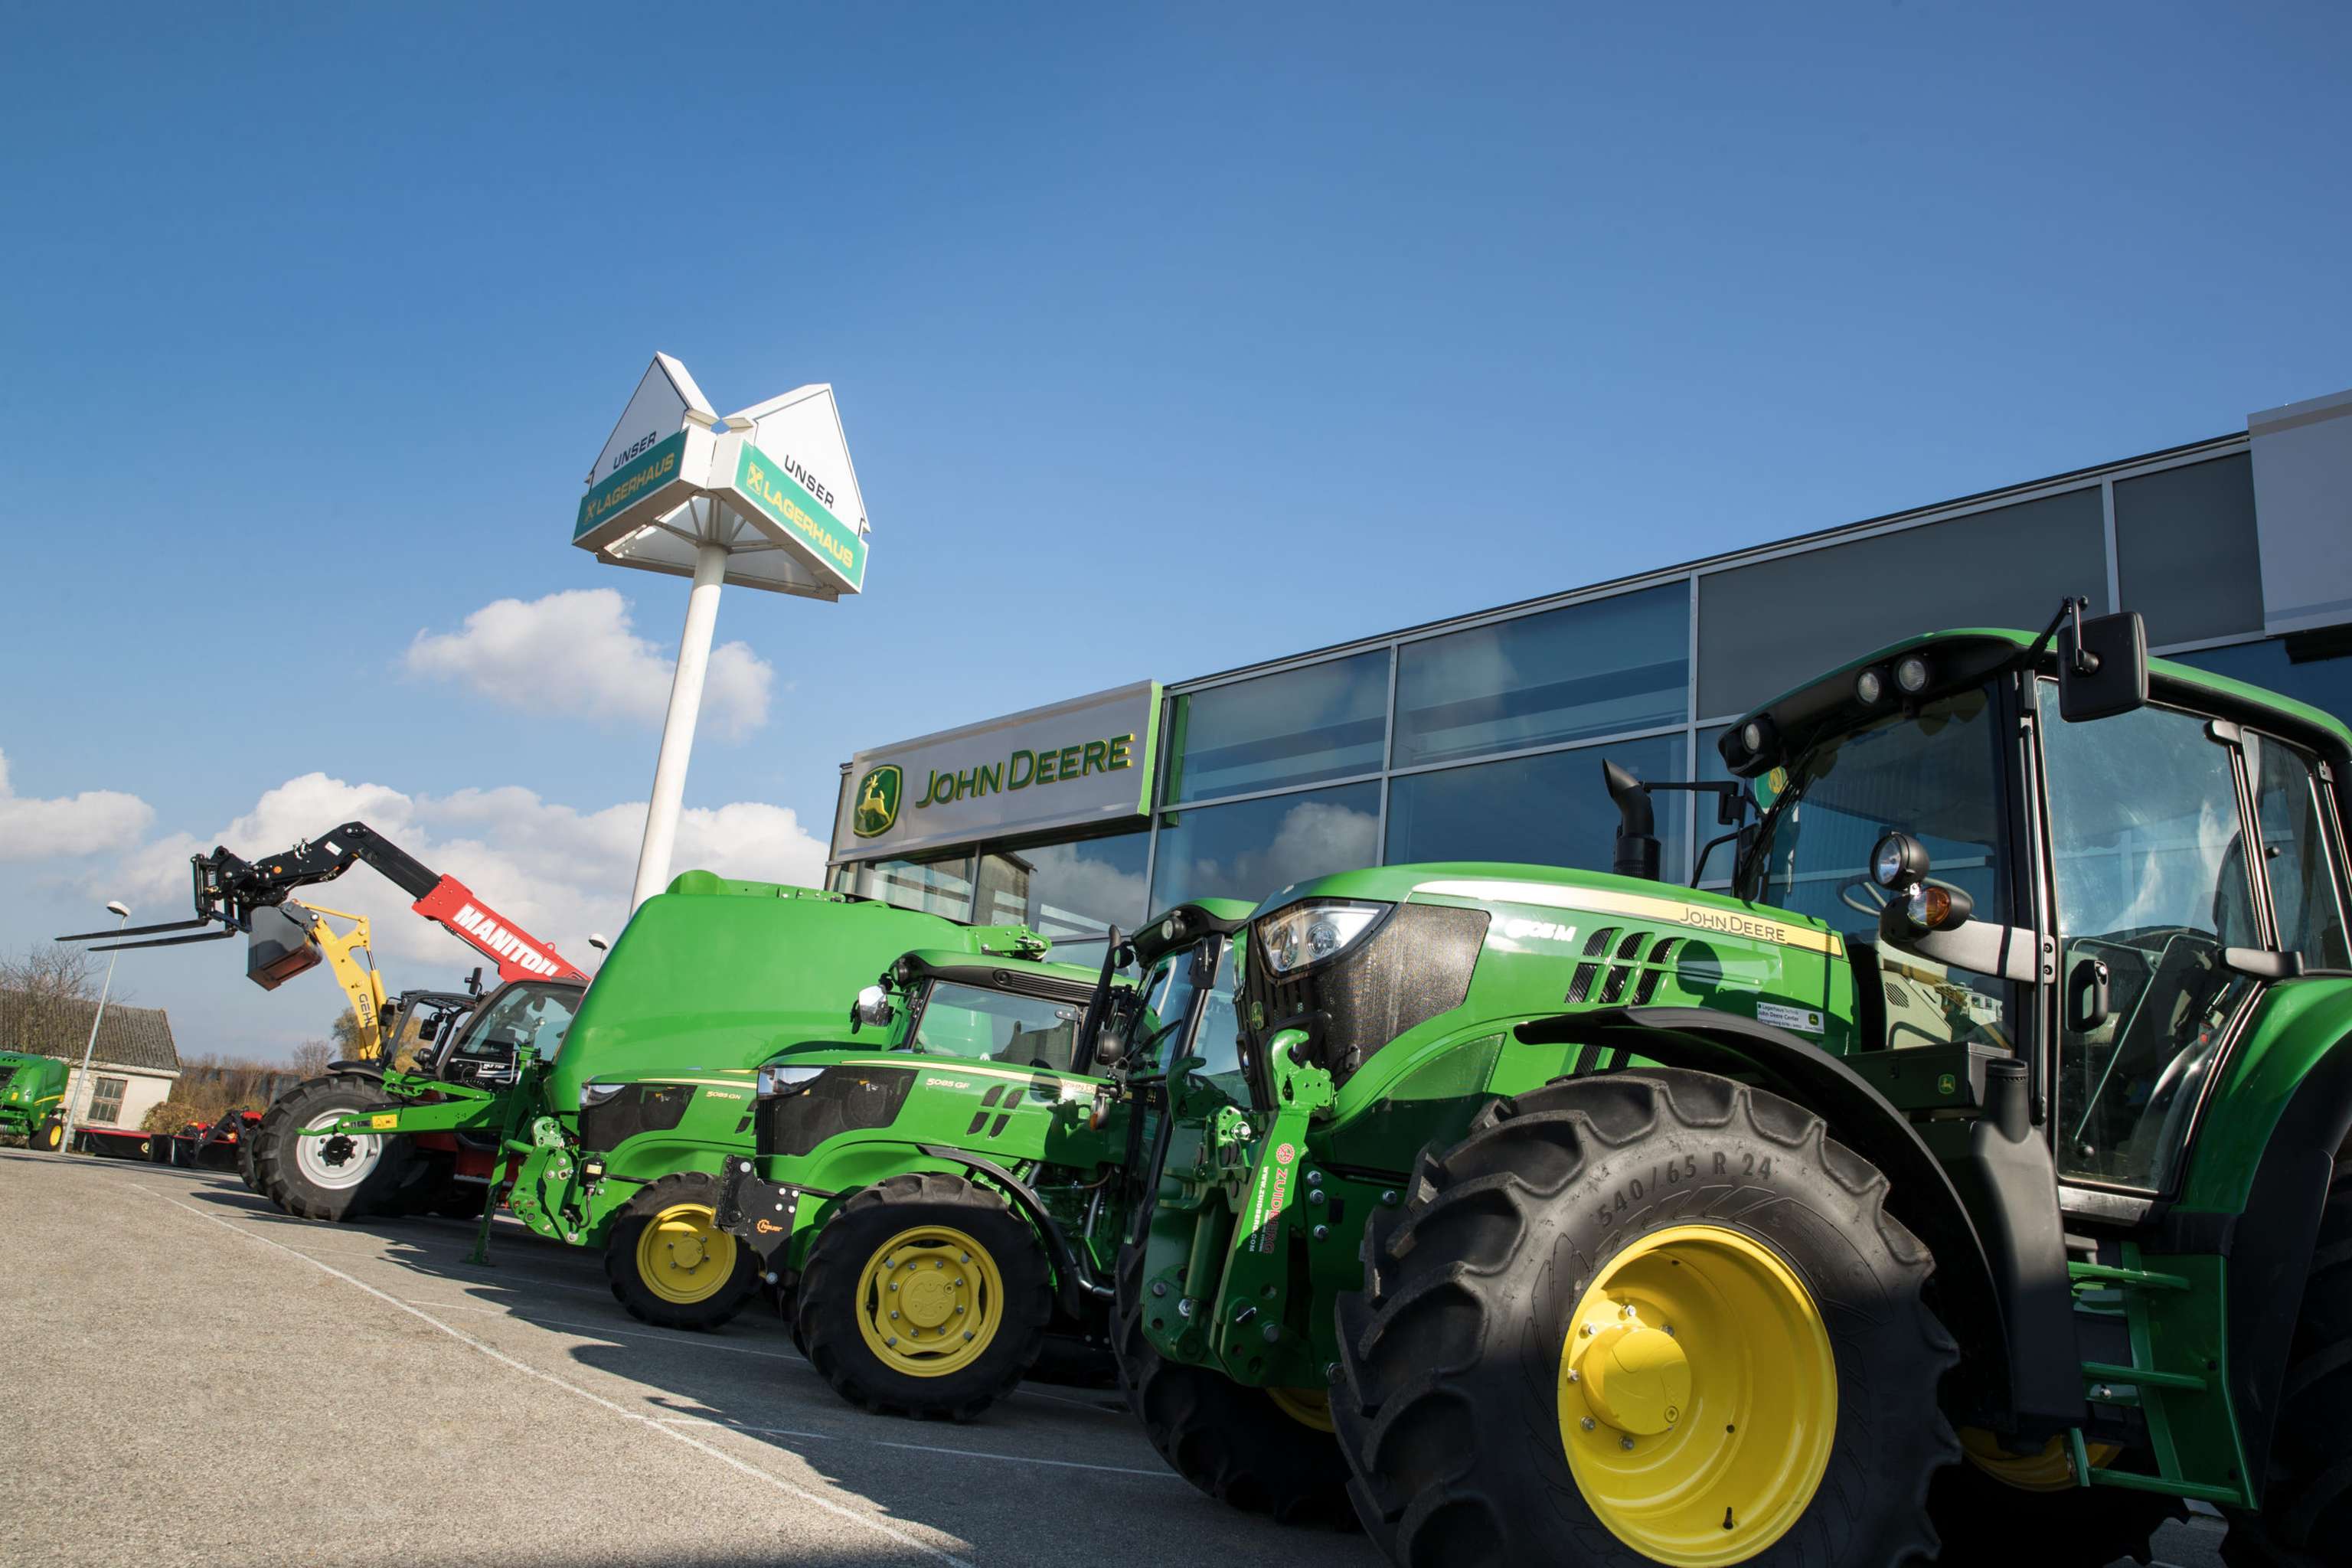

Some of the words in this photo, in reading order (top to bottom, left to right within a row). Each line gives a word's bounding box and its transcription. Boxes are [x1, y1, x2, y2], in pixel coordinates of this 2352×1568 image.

[613, 431, 657, 470] UNSER
[596, 452, 675, 514] LAGERHAUS
[785, 455, 835, 509] UNSER
[764, 481, 853, 569] LAGERHAUS
[916, 761, 1004, 809] JOHN
[1008, 732, 1135, 792] DEERE
[1680, 907, 1726, 929] JOHN
[1730, 916, 1786, 942] DEERE
[926, 1077, 954, 1087] 5085
[1712, 1151, 1726, 1175] R
[1741, 1153, 1772, 1181] 24
[1263, 1168, 1288, 1254] ZUIDBERG
